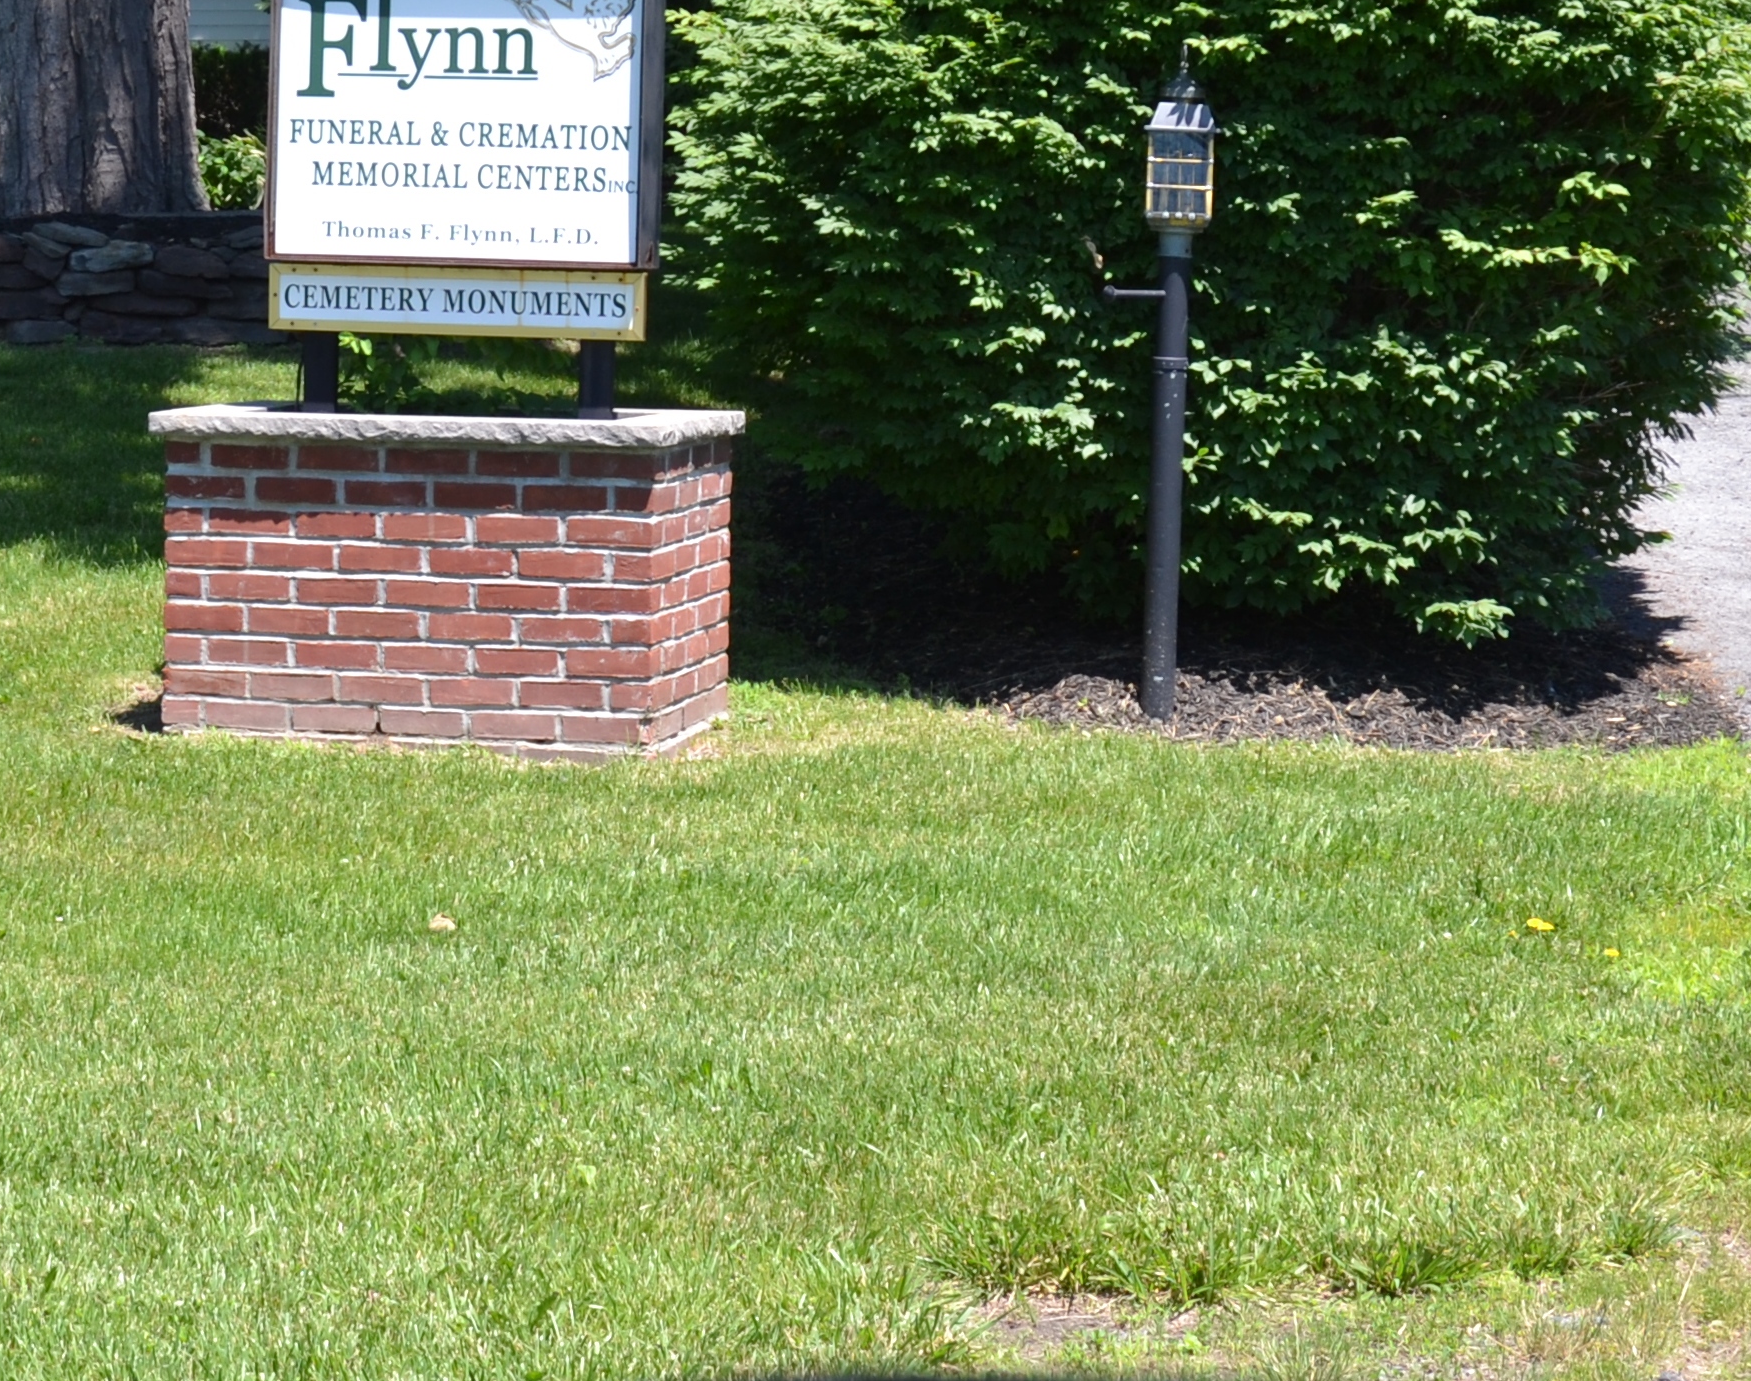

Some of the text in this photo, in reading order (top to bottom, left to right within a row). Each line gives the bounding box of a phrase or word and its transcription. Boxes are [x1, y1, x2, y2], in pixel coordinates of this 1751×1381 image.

[289, 118, 632, 151] FUNERAL & CREMATION
[311, 161, 468, 189] MEMORIAL
[477, 164, 607, 193] CENTERS
[322, 220, 599, 246] Thomas F. Flynn, L.F.D.
[283, 283, 627, 318] CEMETERY MONUMENTS
